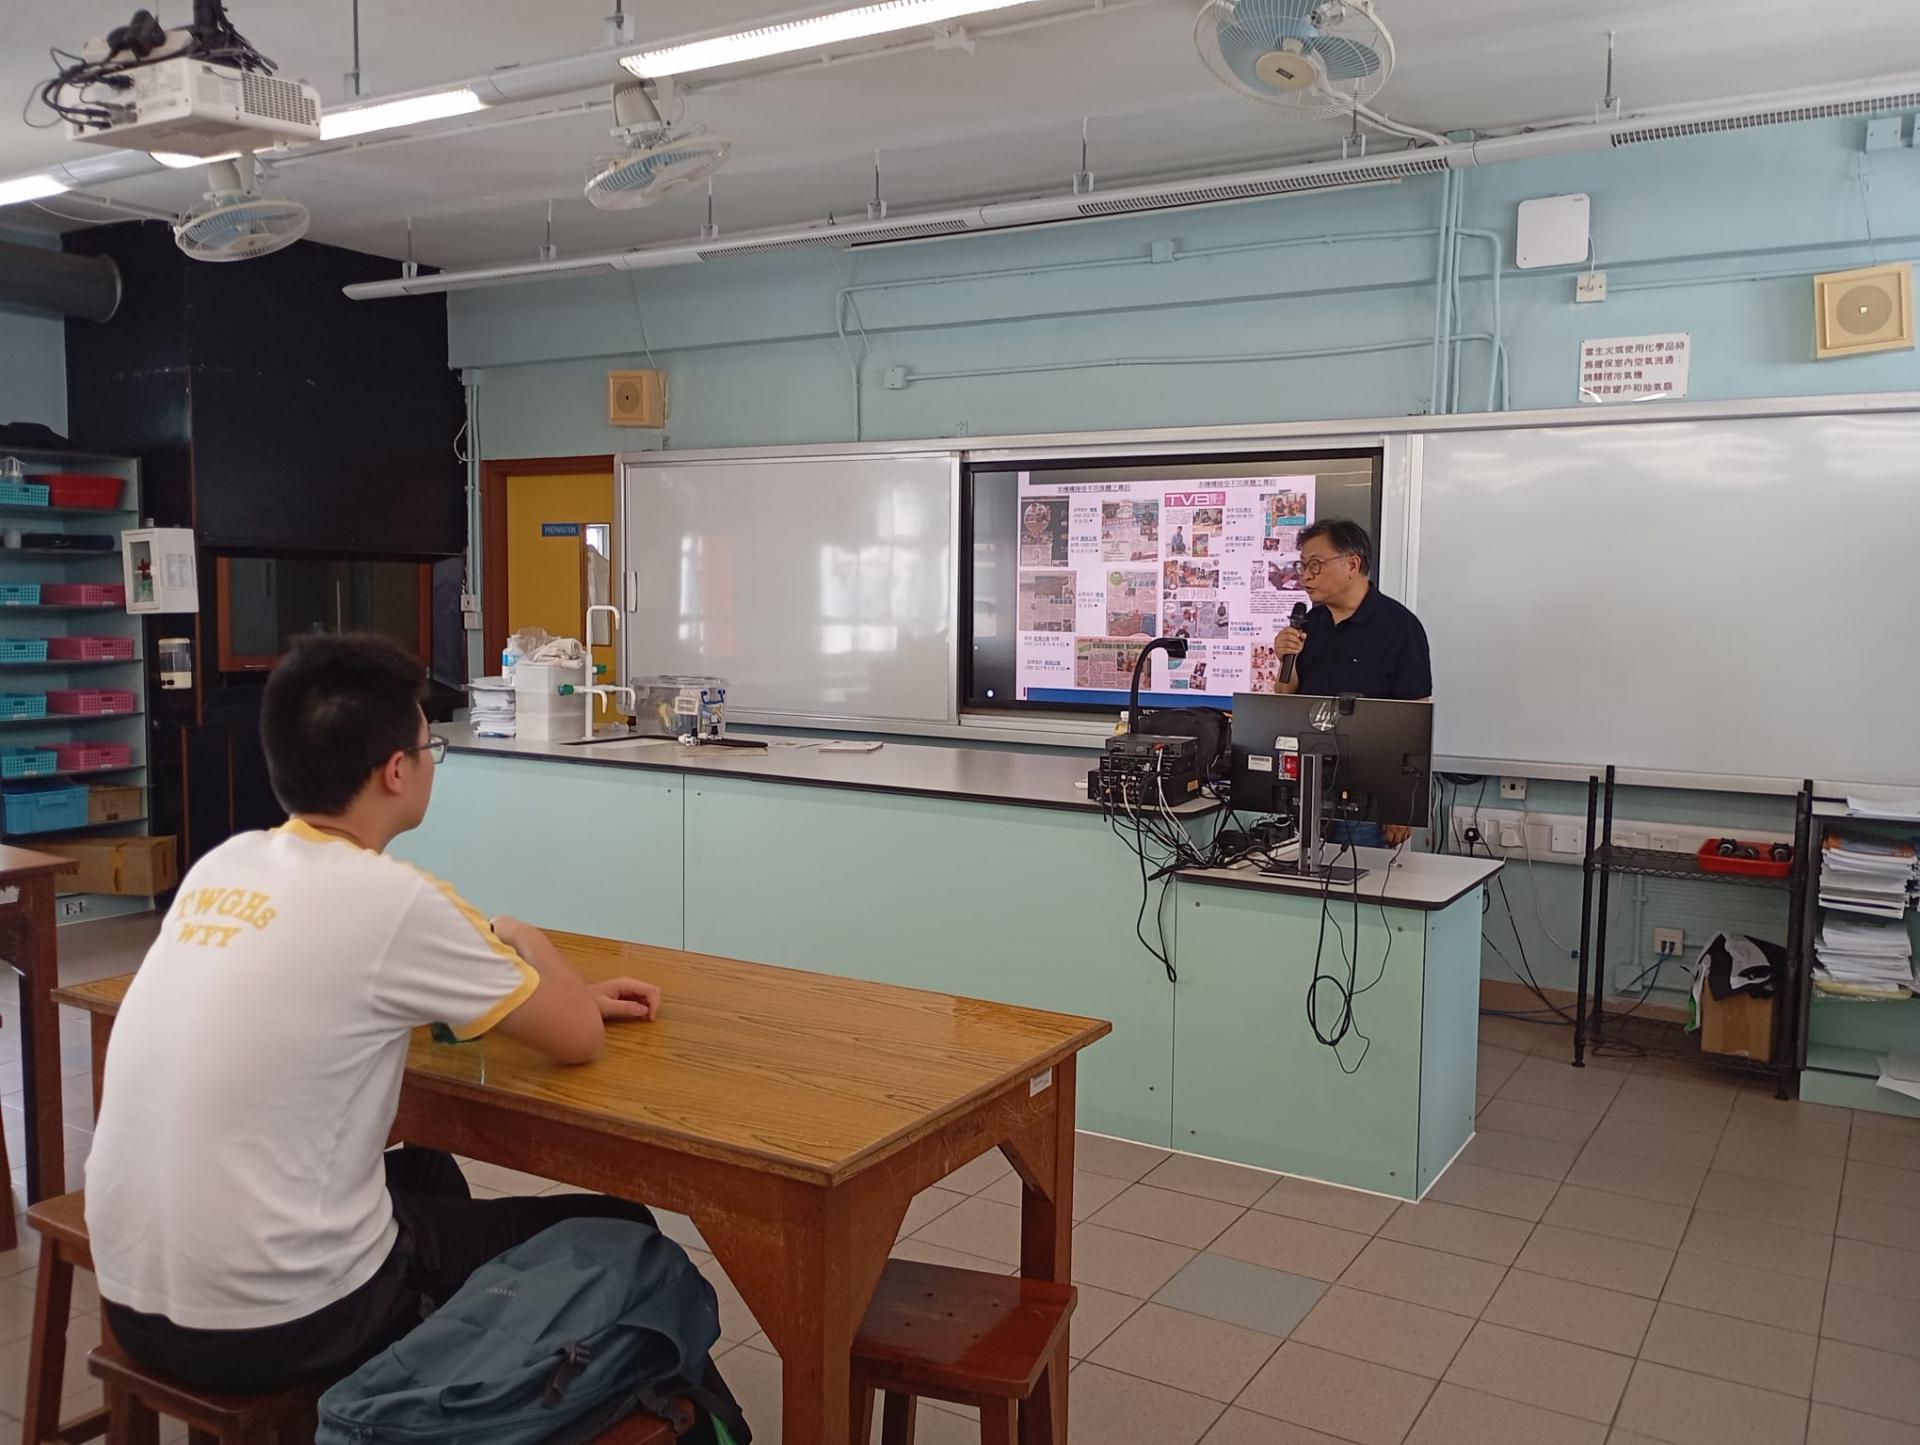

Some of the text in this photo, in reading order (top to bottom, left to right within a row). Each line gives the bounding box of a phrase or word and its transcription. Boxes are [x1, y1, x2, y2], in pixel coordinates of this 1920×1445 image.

[1584, 371, 1643, 382] 請關閉冷氣機
[176, 887, 278, 930] TWGHs
[177, 924, 242, 948] WYY
